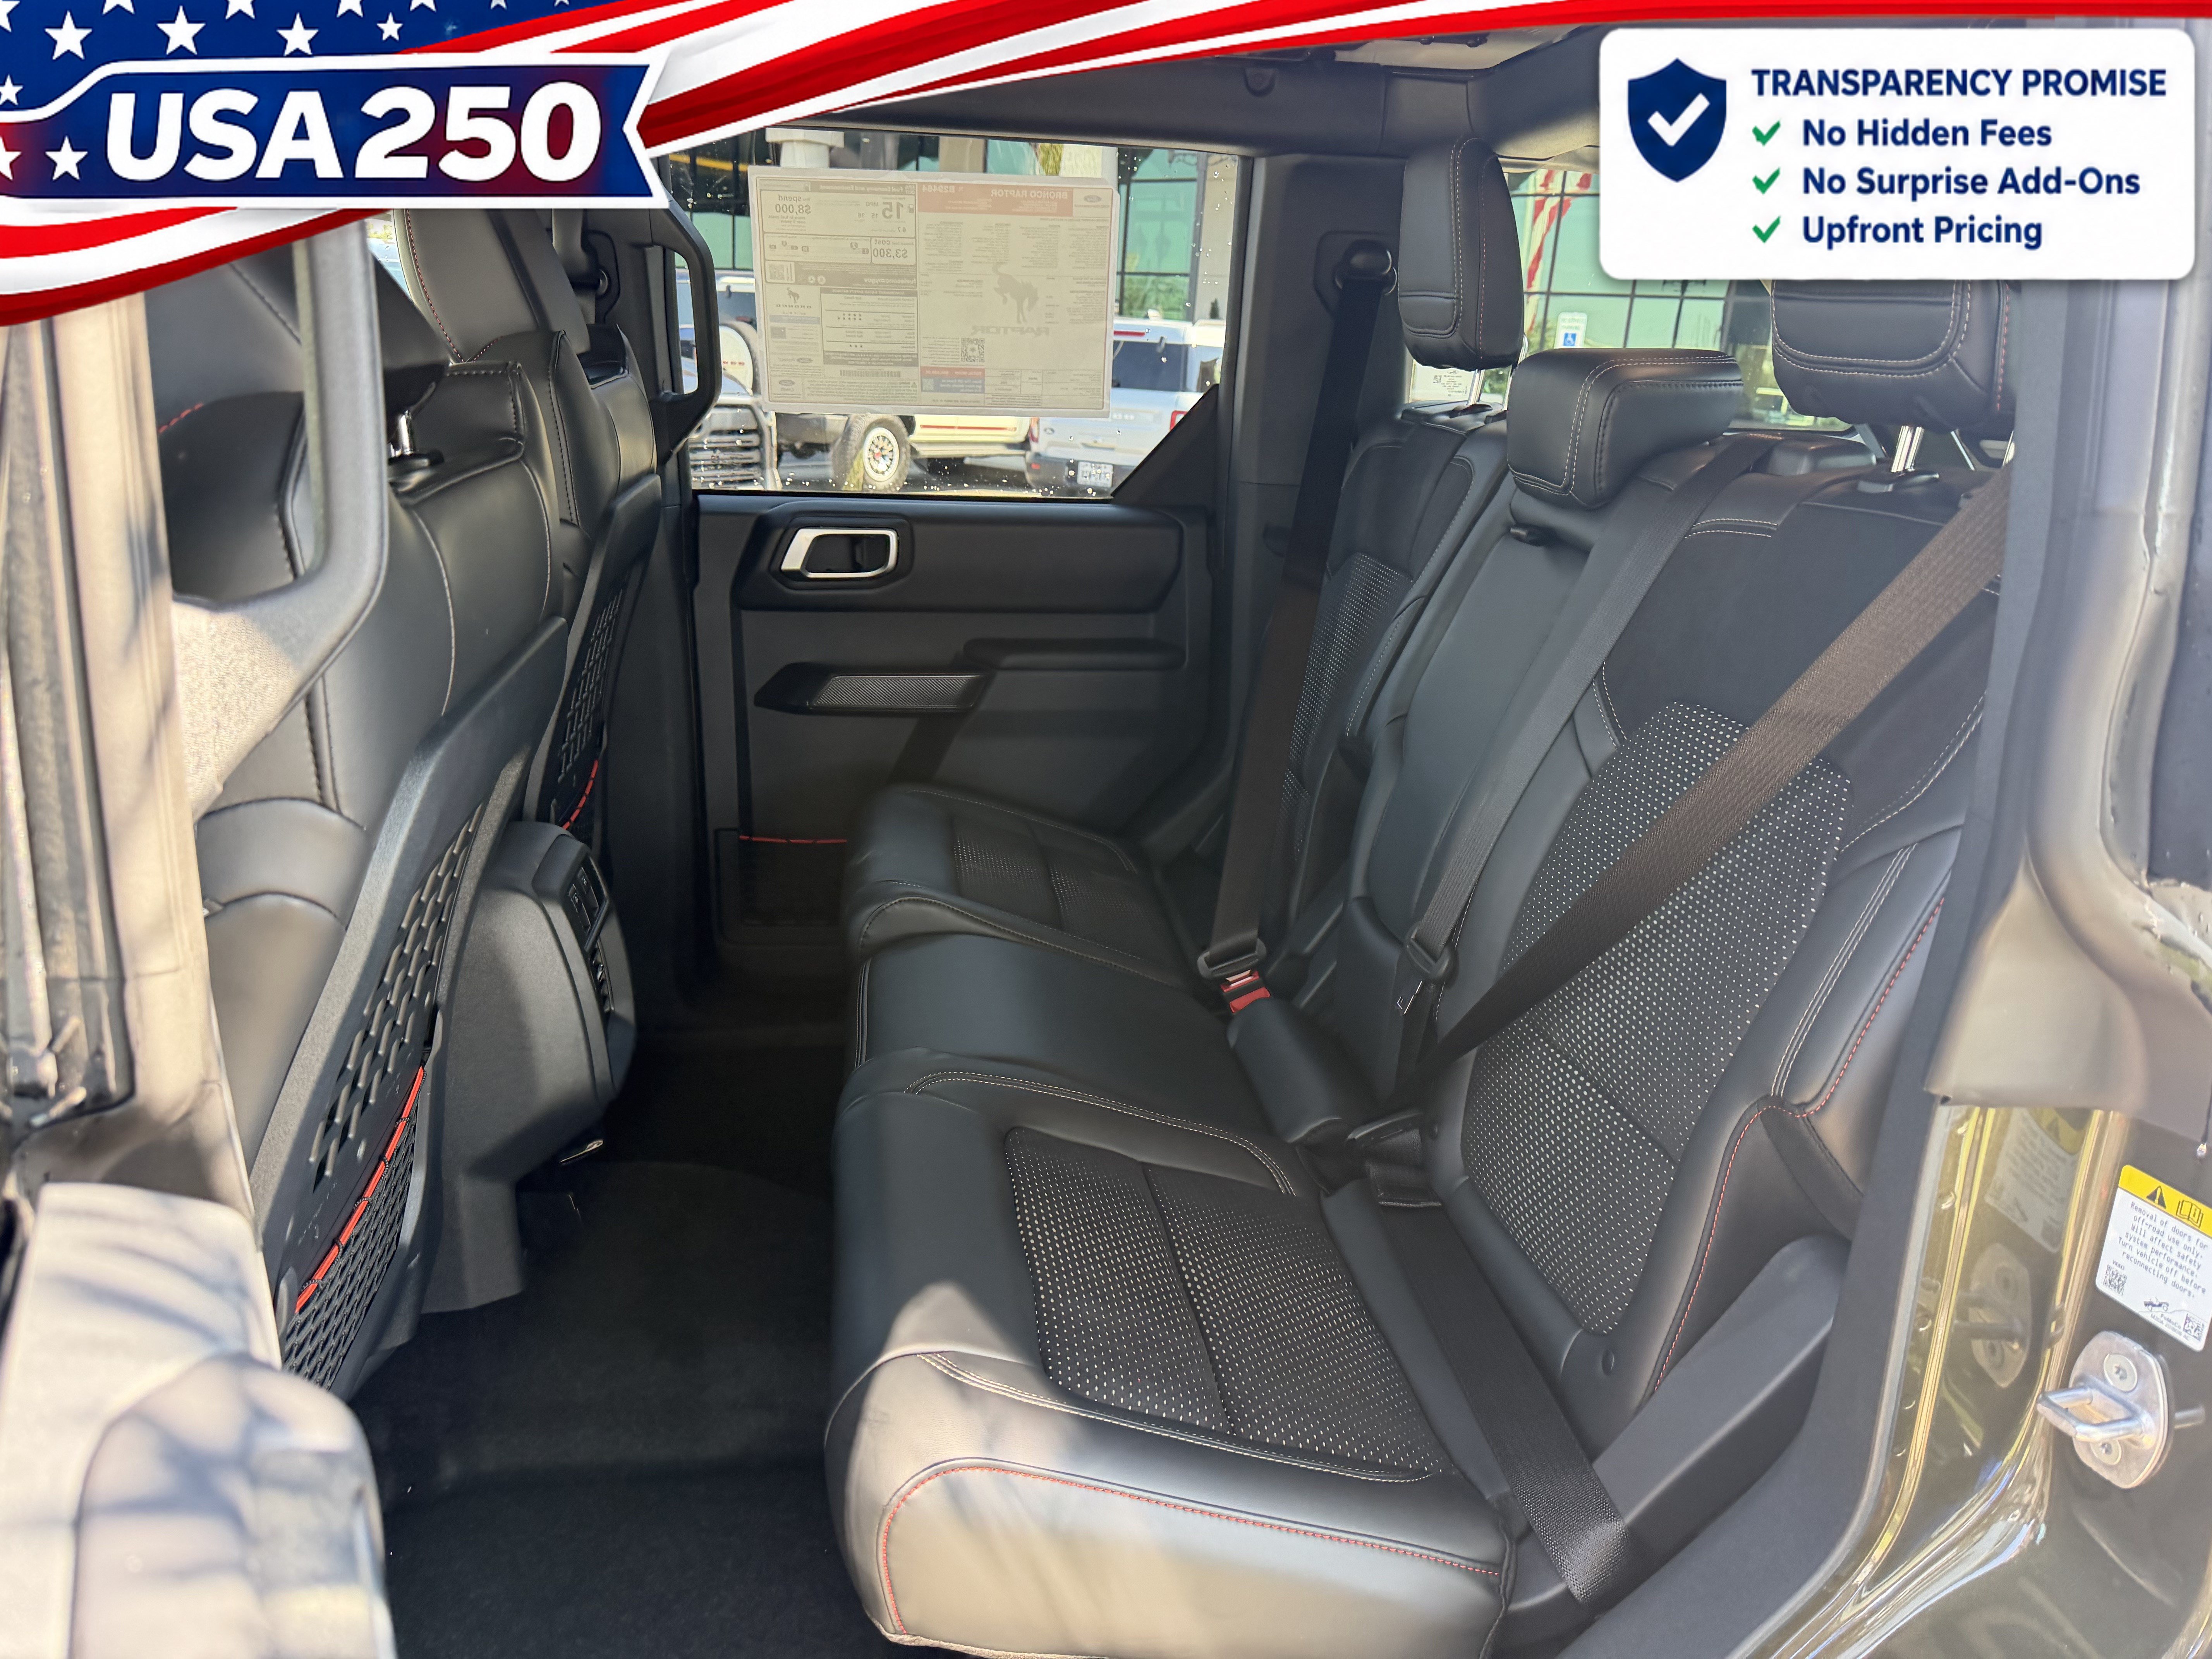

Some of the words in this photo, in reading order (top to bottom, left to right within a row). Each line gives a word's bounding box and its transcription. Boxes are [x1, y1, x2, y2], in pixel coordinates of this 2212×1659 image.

[2131, 1202, 2157, 1222] Removal
[2171, 1226, 2192, 1242] doors
[2196, 1238, 2208, 1250] for
[2131, 1223, 2146, 1238] Will
[2150, 1236, 2173, 1254] affect
[2177, 1251, 2201, 1270] safety
[2134, 1216, 2165, 1237] off-road
[2167, 1234, 2180, 1246] use
[2183, 1244, 2203, 1259] only.
[2119, 1236, 2133, 1251] Turn
[2136, 1249, 2163, 1269] vehicle
[2166, 1267, 2178, 1278] off
[2181, 1273, 2206, 1294] before
[2123, 1251, 2168, 1285] reconnecting
[2171, 1280, 2195, 1298] doors.
[2125, 1232, 2148, 1249] system
[2151, 1247, 2198, 1278] performance.
